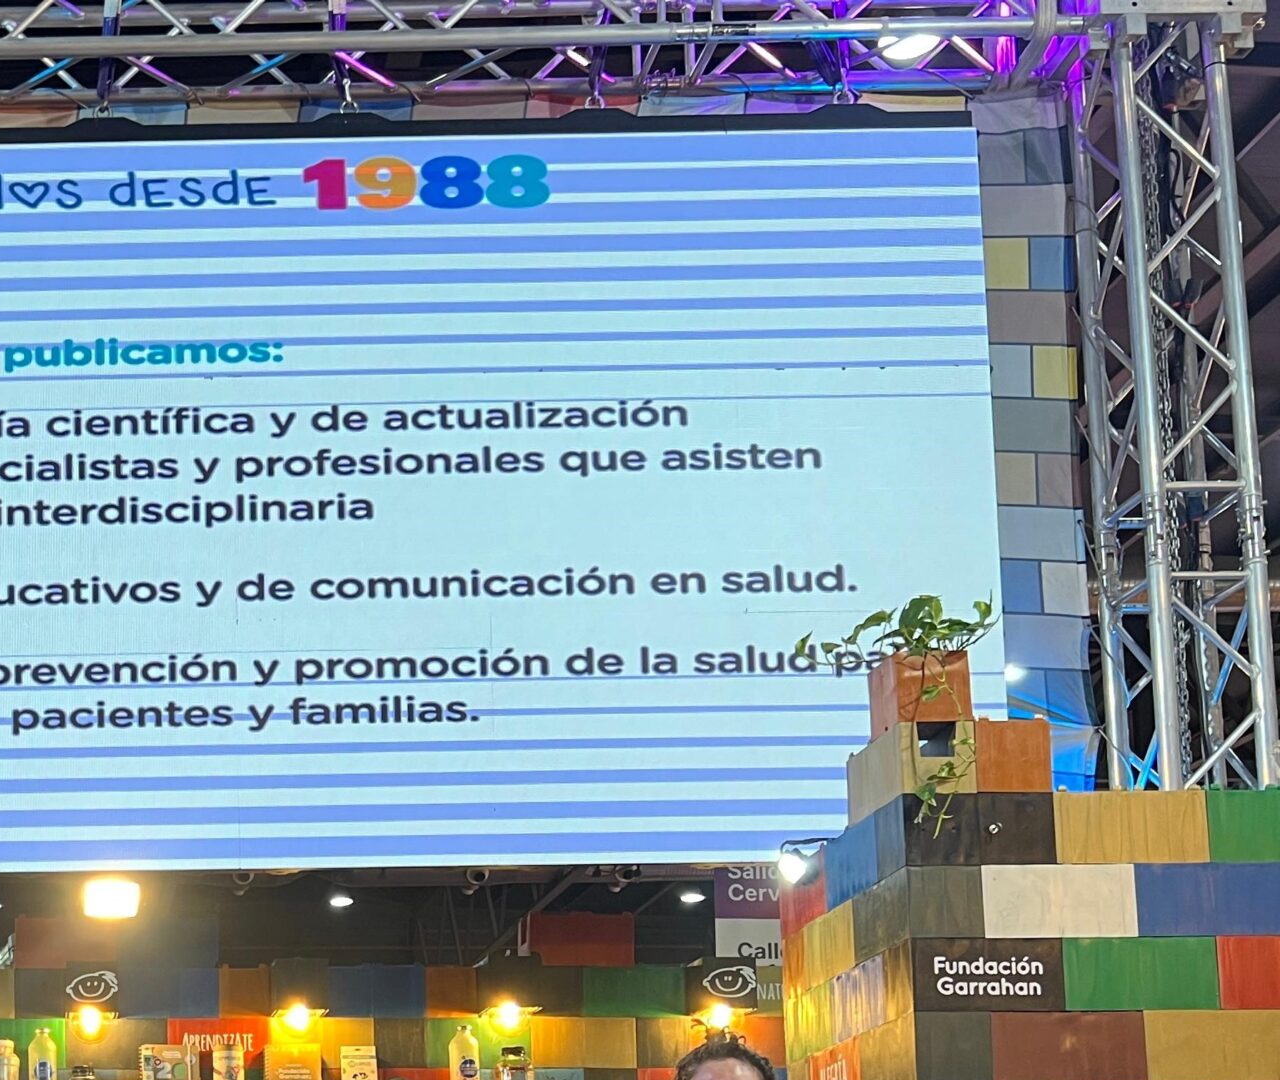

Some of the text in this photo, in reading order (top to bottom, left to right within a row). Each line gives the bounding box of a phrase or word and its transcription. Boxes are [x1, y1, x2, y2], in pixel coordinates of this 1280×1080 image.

[302, 153, 551, 210] 1988
[4, 337, 284, 375] publicamos:
[46, 405, 255, 438] científica
[270, 412, 296, 439] y
[312, 404, 368, 433] de
[383, 399, 688, 431] actualización
[193, 457, 220, 484] y
[235, 446, 544, 484] profesionales
[560, 448, 646, 477] que
[661, 443, 821, 471] asisten
[196, 580, 222, 608] y
[237, 573, 295, 602] de
[310, 567, 634, 600] comunicación
[651, 571, 706, 594] en
[722, 565, 858, 594] salud.
[253, 659, 279, 687] y
[295, 646, 549, 686] promoción
[565, 647, 624, 676] de
[641, 646, 677, 674] la
[694, 643, 817, 674] salud
[12, 702, 233, 736] pacientes
[248, 705, 274, 732] y
[289, 695, 480, 726] familias.
[933, 956, 1044, 979] Fundación
[936, 976, 1043, 997] Garrahan
